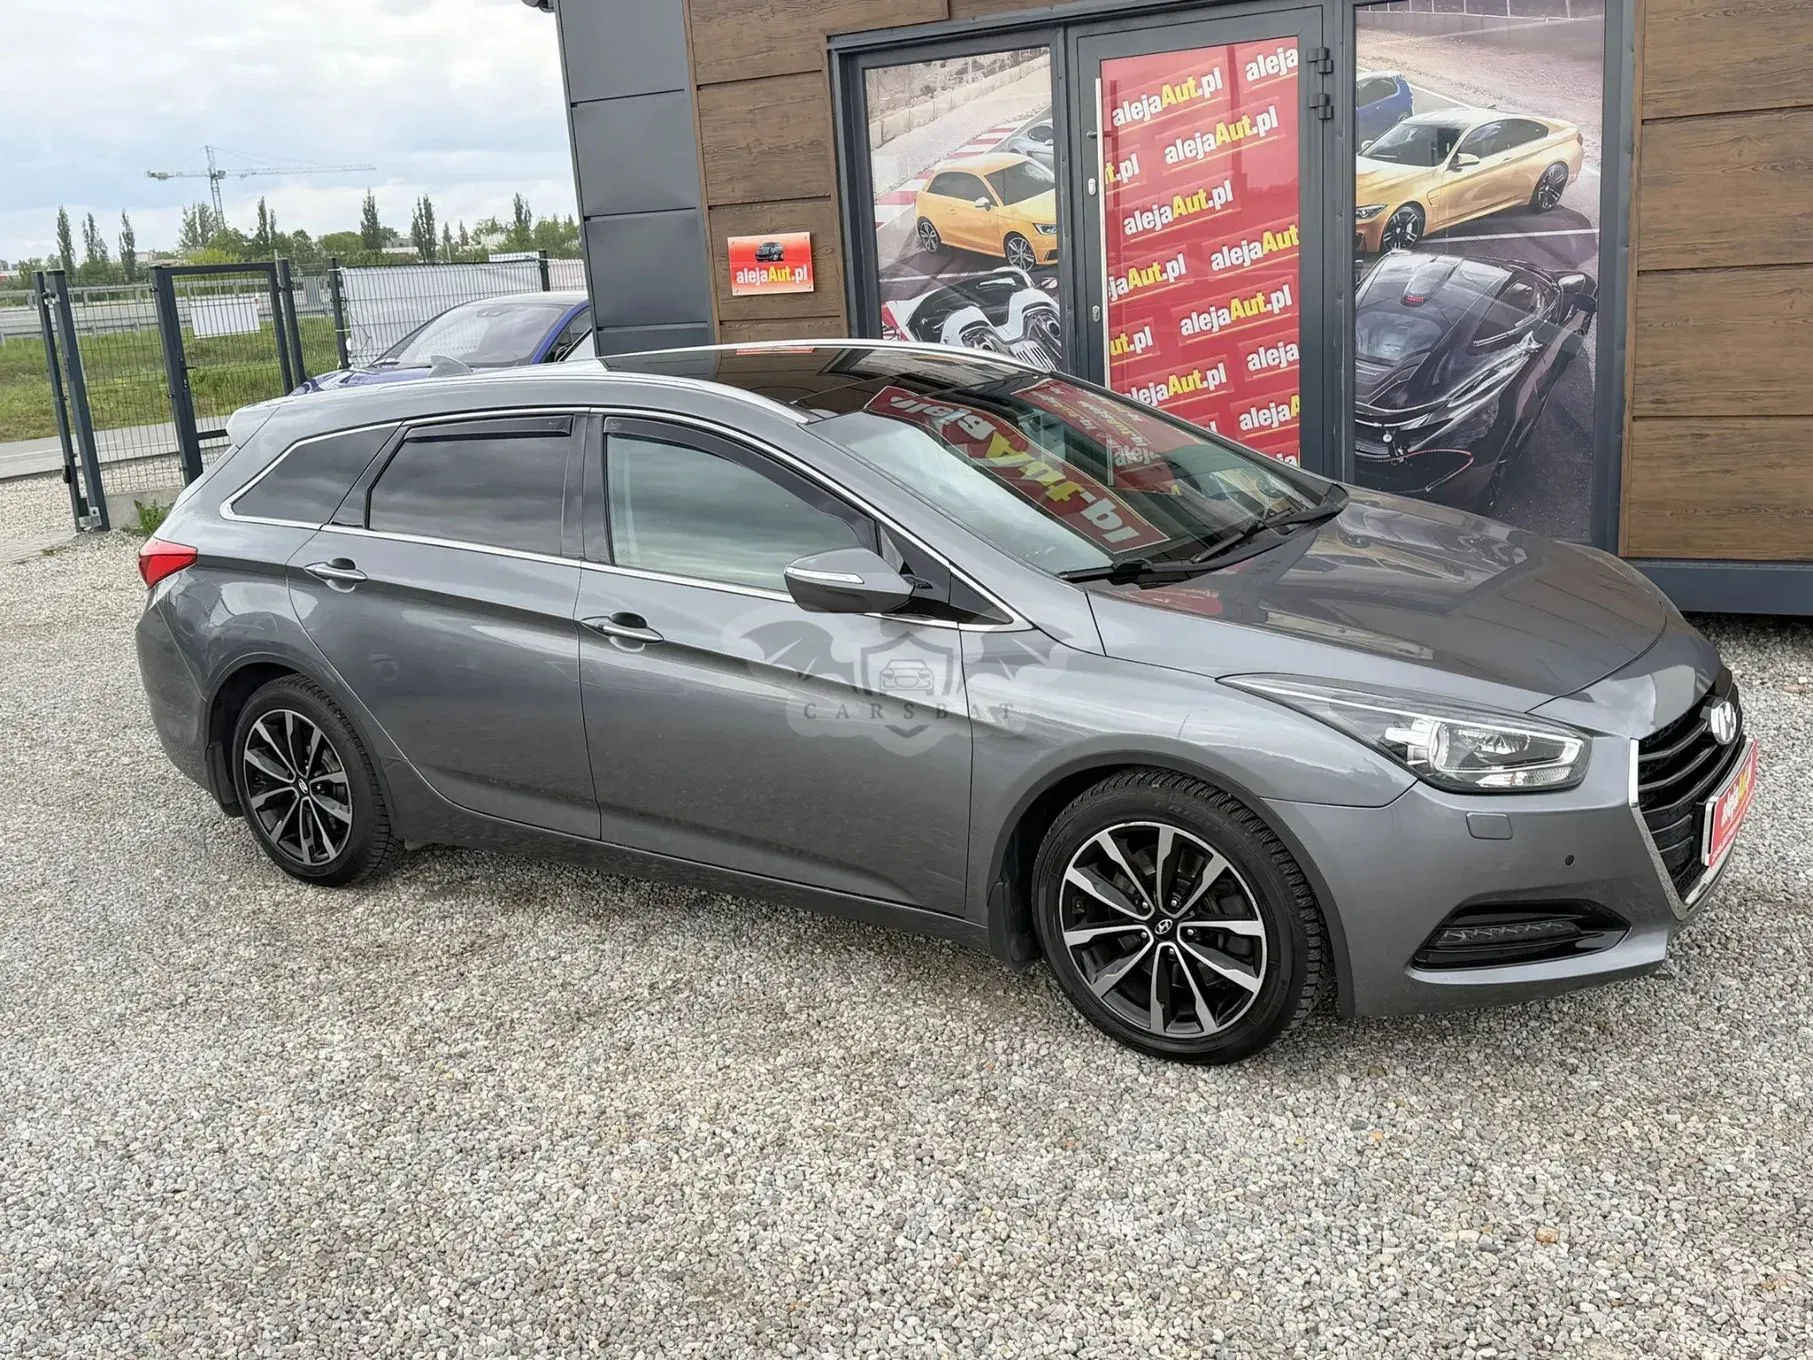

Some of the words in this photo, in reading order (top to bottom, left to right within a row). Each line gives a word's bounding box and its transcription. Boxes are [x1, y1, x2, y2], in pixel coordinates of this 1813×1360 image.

[1112, 67, 1223, 127] alejaAut.pl
[1164, 105, 1279, 165] alejaAut.pl
[1105, 153, 1140, 184] t.pl
[1123, 179, 1234, 236] alejaAut.pl
[1210, 224, 1299, 271] alejaAut
[736, 263, 809, 286] alejaAut.pl
[1108, 253, 1187, 302] jaAut.pl
[1180, 284, 1293, 336] alejaAut.pl
